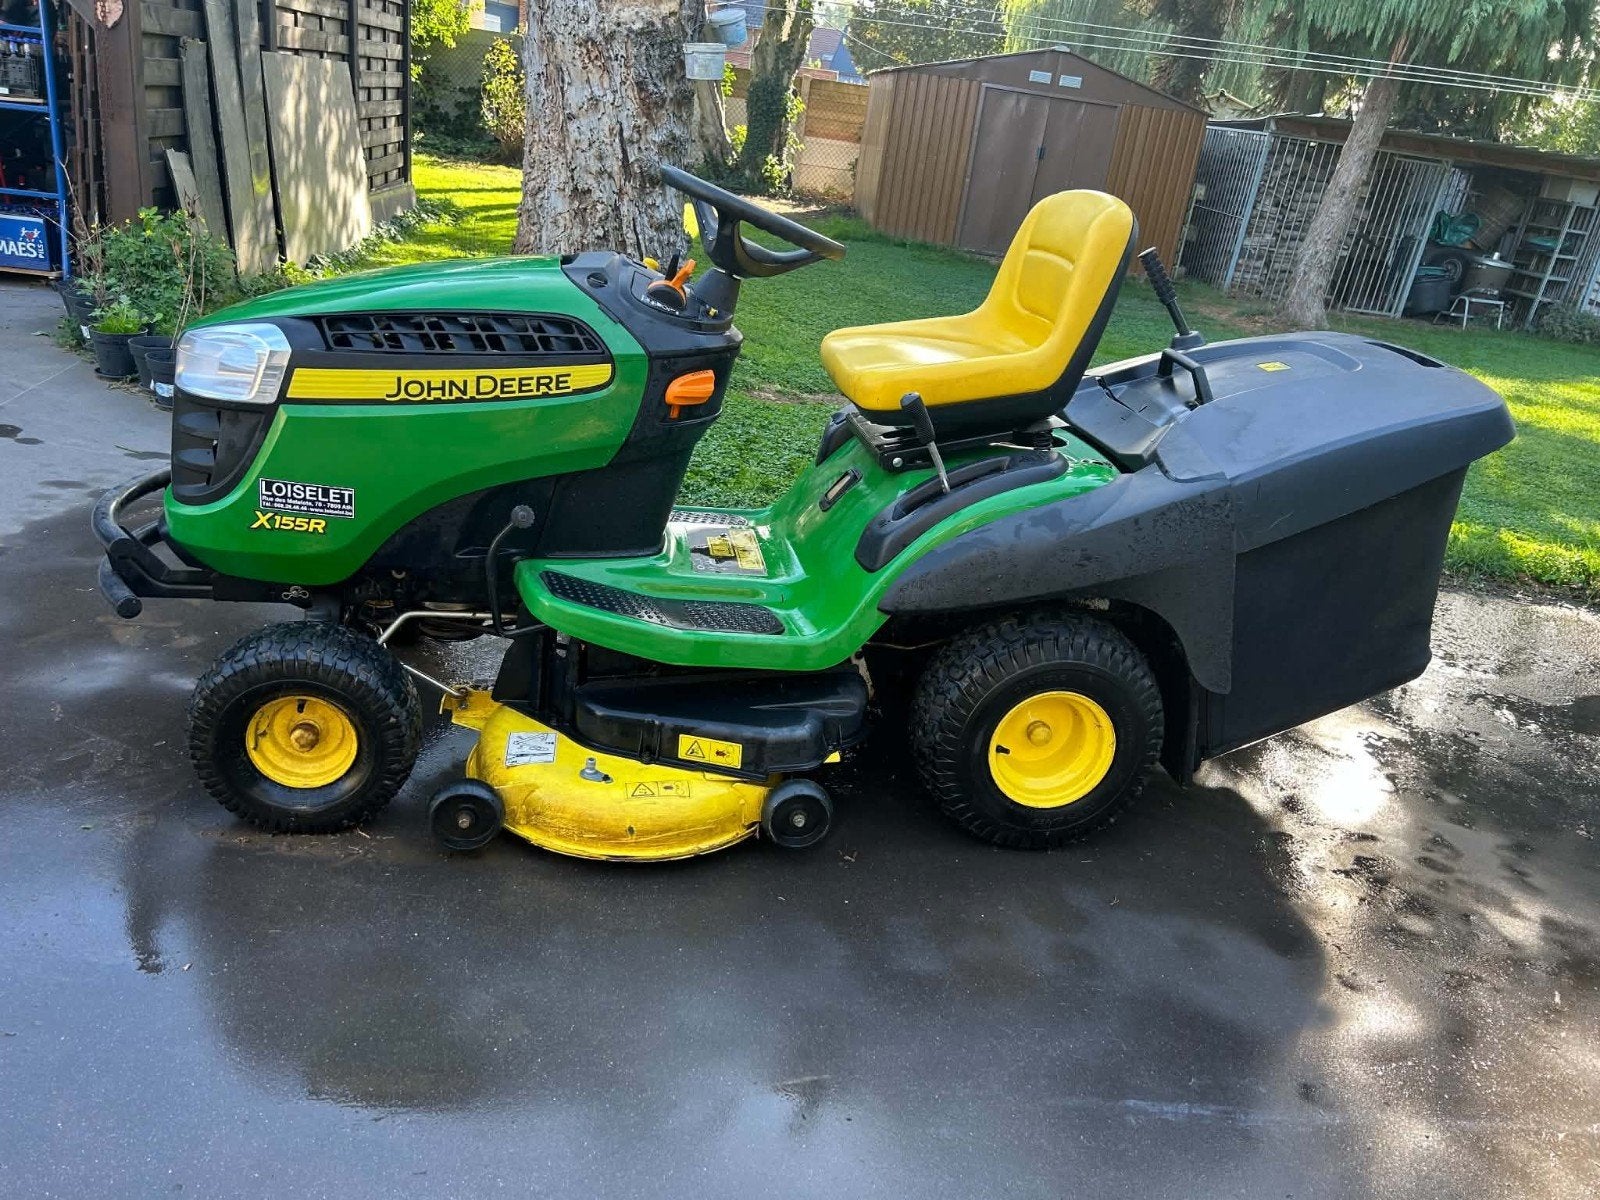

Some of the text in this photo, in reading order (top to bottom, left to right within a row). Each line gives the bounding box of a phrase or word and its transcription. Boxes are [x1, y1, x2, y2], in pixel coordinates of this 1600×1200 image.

[385, 373, 572, 399] JOHN DEERE
[261, 480, 353, 504] LOISELET
[250, 510, 326, 534] X155R
